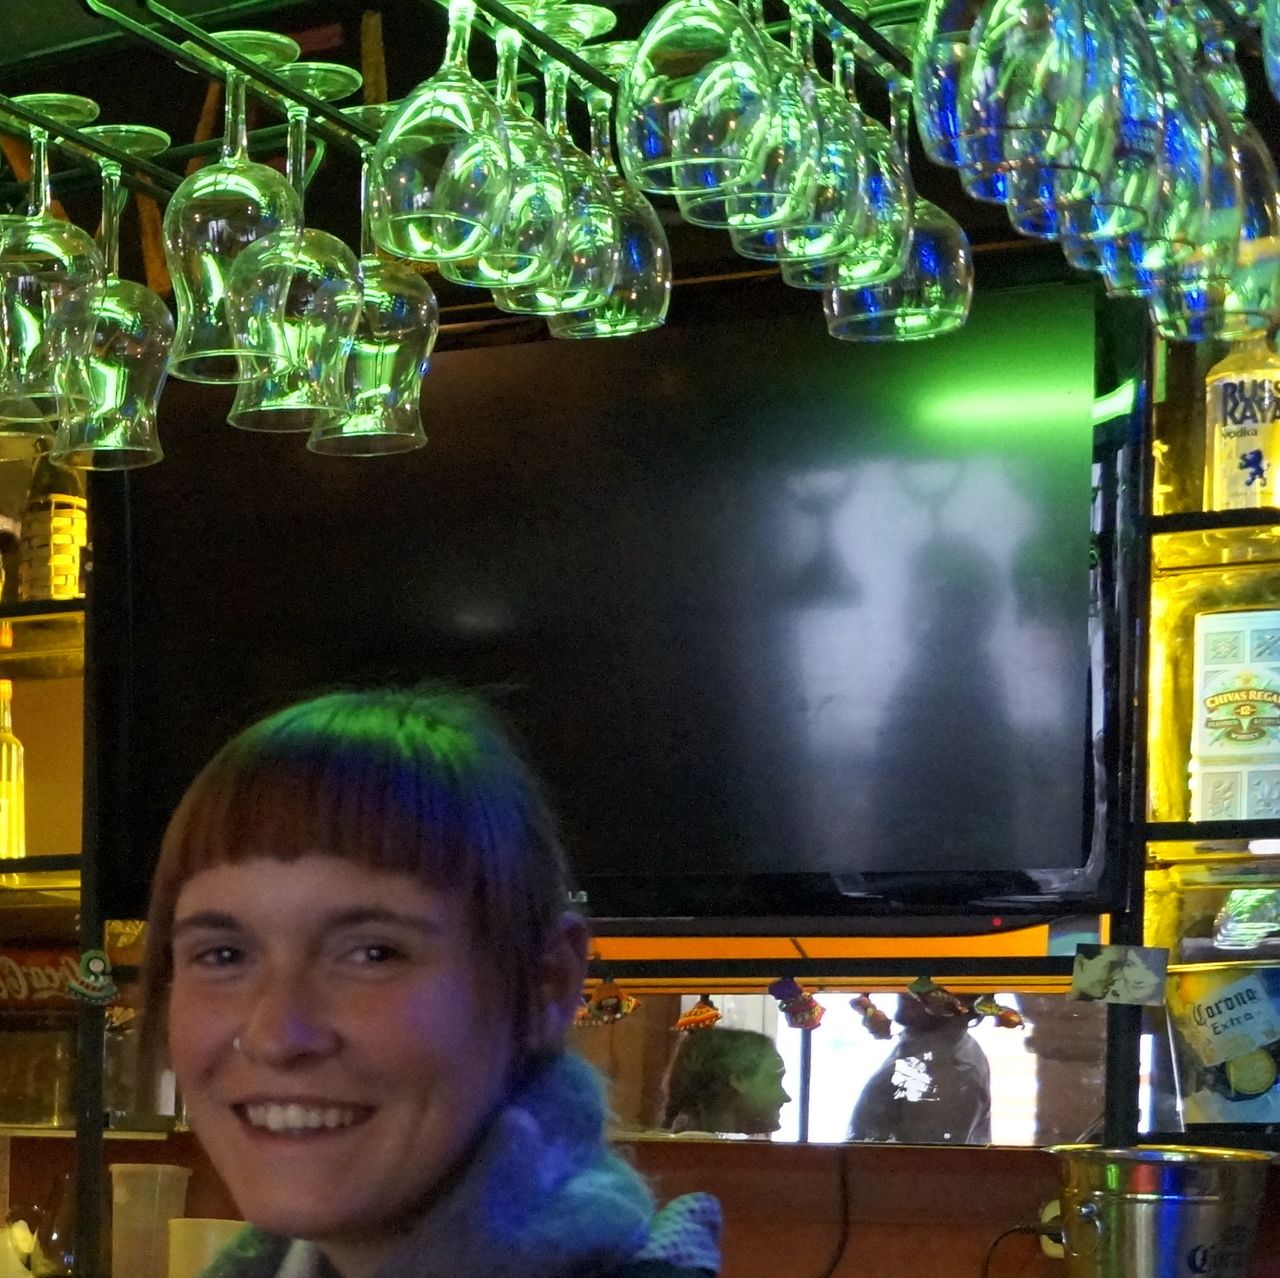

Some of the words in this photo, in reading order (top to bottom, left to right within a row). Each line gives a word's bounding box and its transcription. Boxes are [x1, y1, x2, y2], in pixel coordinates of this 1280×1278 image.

[1205, 691, 1247, 707] CHIVAS
[1193, 988, 1258, 1026] Corona
[1212, 1012, 1254, 1035] Extra
